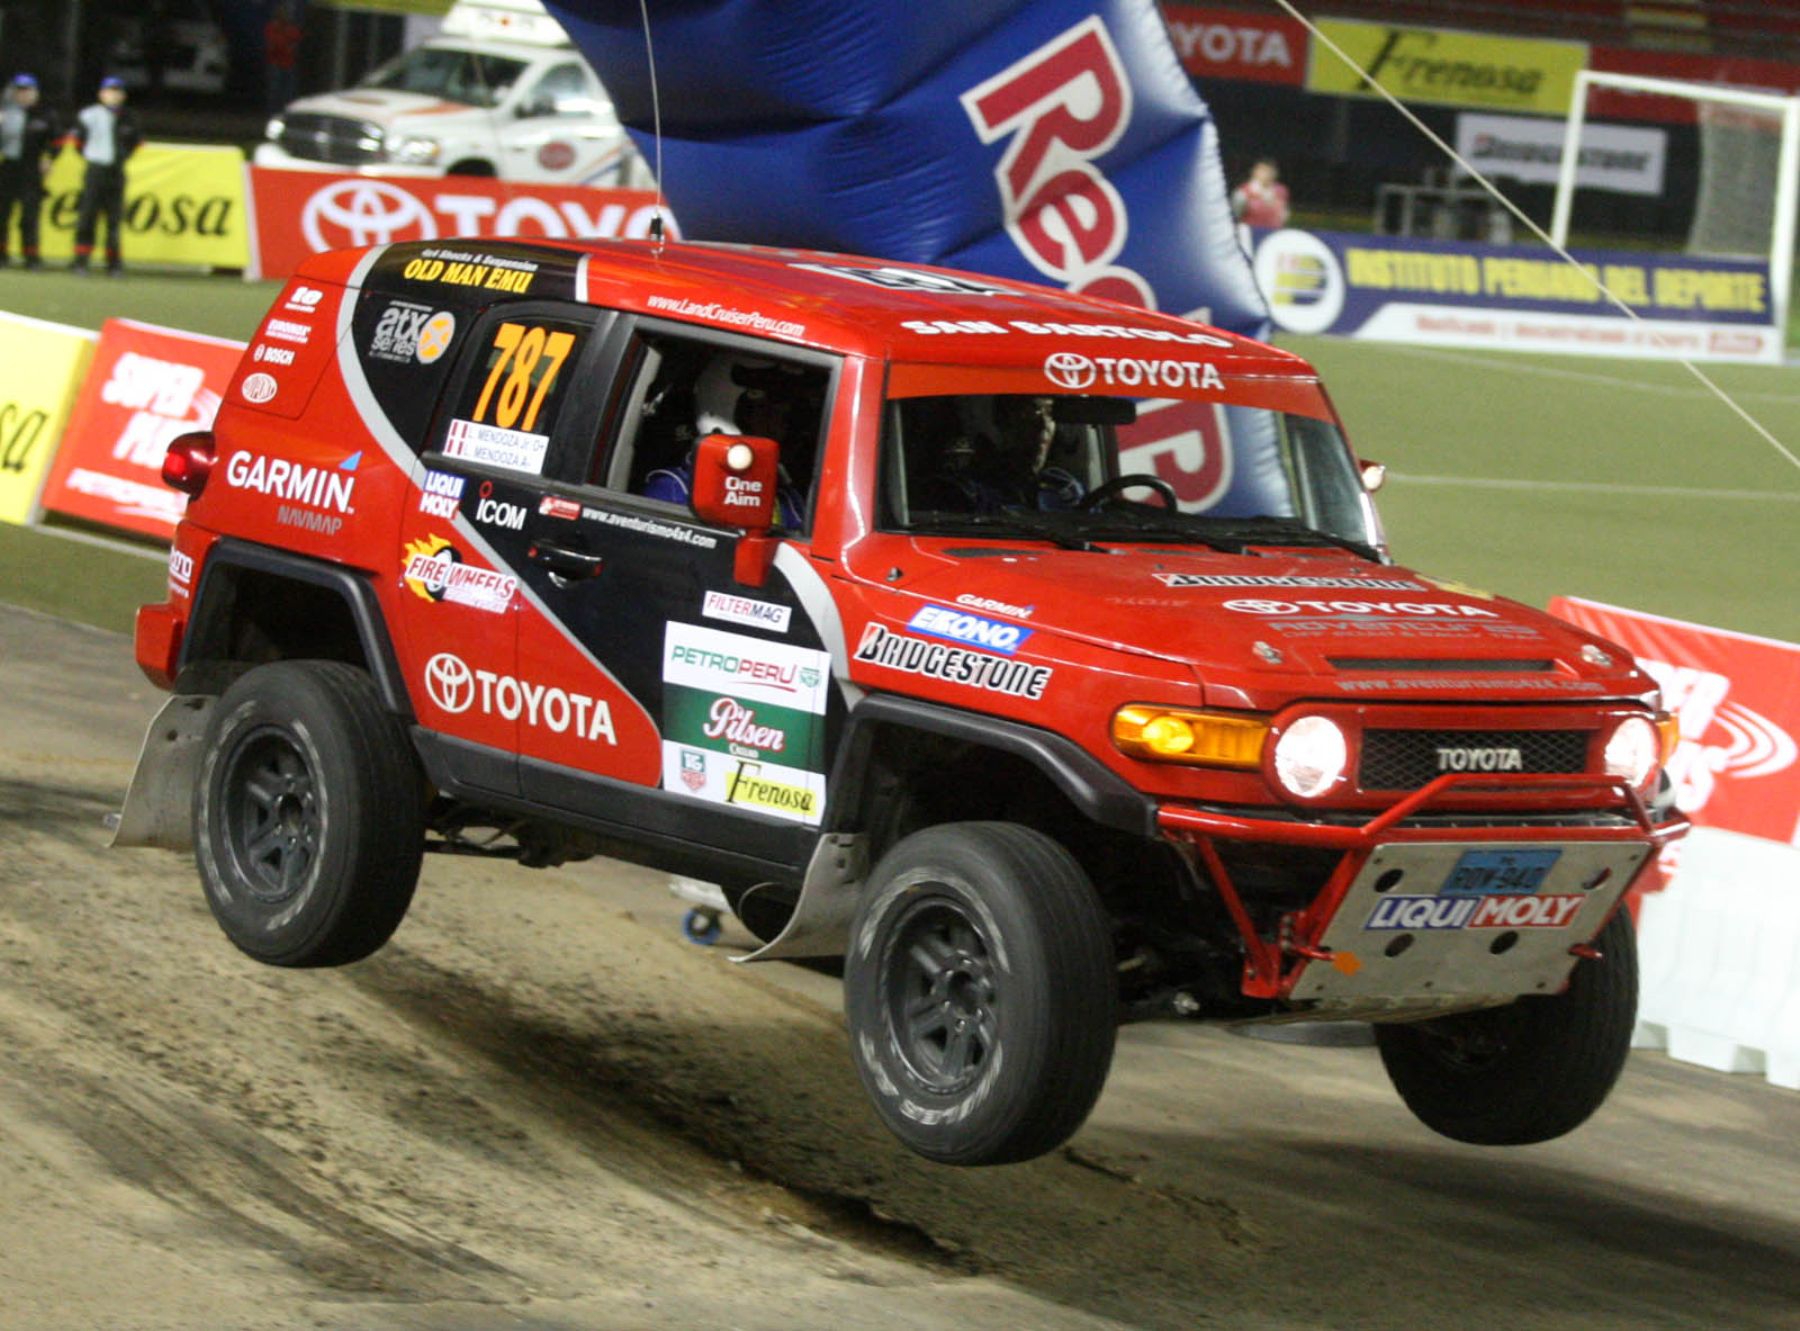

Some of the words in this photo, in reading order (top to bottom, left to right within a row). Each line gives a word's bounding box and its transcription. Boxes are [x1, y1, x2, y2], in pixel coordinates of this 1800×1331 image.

[1169, 22, 1293, 67] YOTA
[404, 259, 444, 281] OLD
[440, 262, 488, 287] MAN
[484, 268, 534, 294] EMU
[900, 320, 1009, 335] SAN
[1008, 321, 1233, 348] BARTOLO
[472, 322, 576, 432] 787
[1095, 357, 1226, 390] TOYOTA
[425, 471, 465, 498] LIQUI
[724, 491, 761, 507] Aim
[725, 476, 762, 492] One
[419, 493, 460, 519] MOLY
[476, 498, 527, 530] ICOM
[408, 557, 447, 583] FIRE
[449, 562, 516, 599] WHEELS
[707, 594, 784, 623] FILTERMAG
[956, 593, 1034, 619] GARMIN
[1296, 600, 1499, 618] TOYOTA
[908, 606, 1020, 649] EKONO
[855, 623, 1052, 699] BRIDGESTONE
[475, 669, 618, 746] TOYOTA
[702, 697, 786, 753] Pilsen
[1437, 748, 1523, 771] TOYOTA
[725, 760, 813, 812] Frenosa
[1369, 899, 1478, 929] LIQUI
[1473, 896, 1585, 926] MOLY
